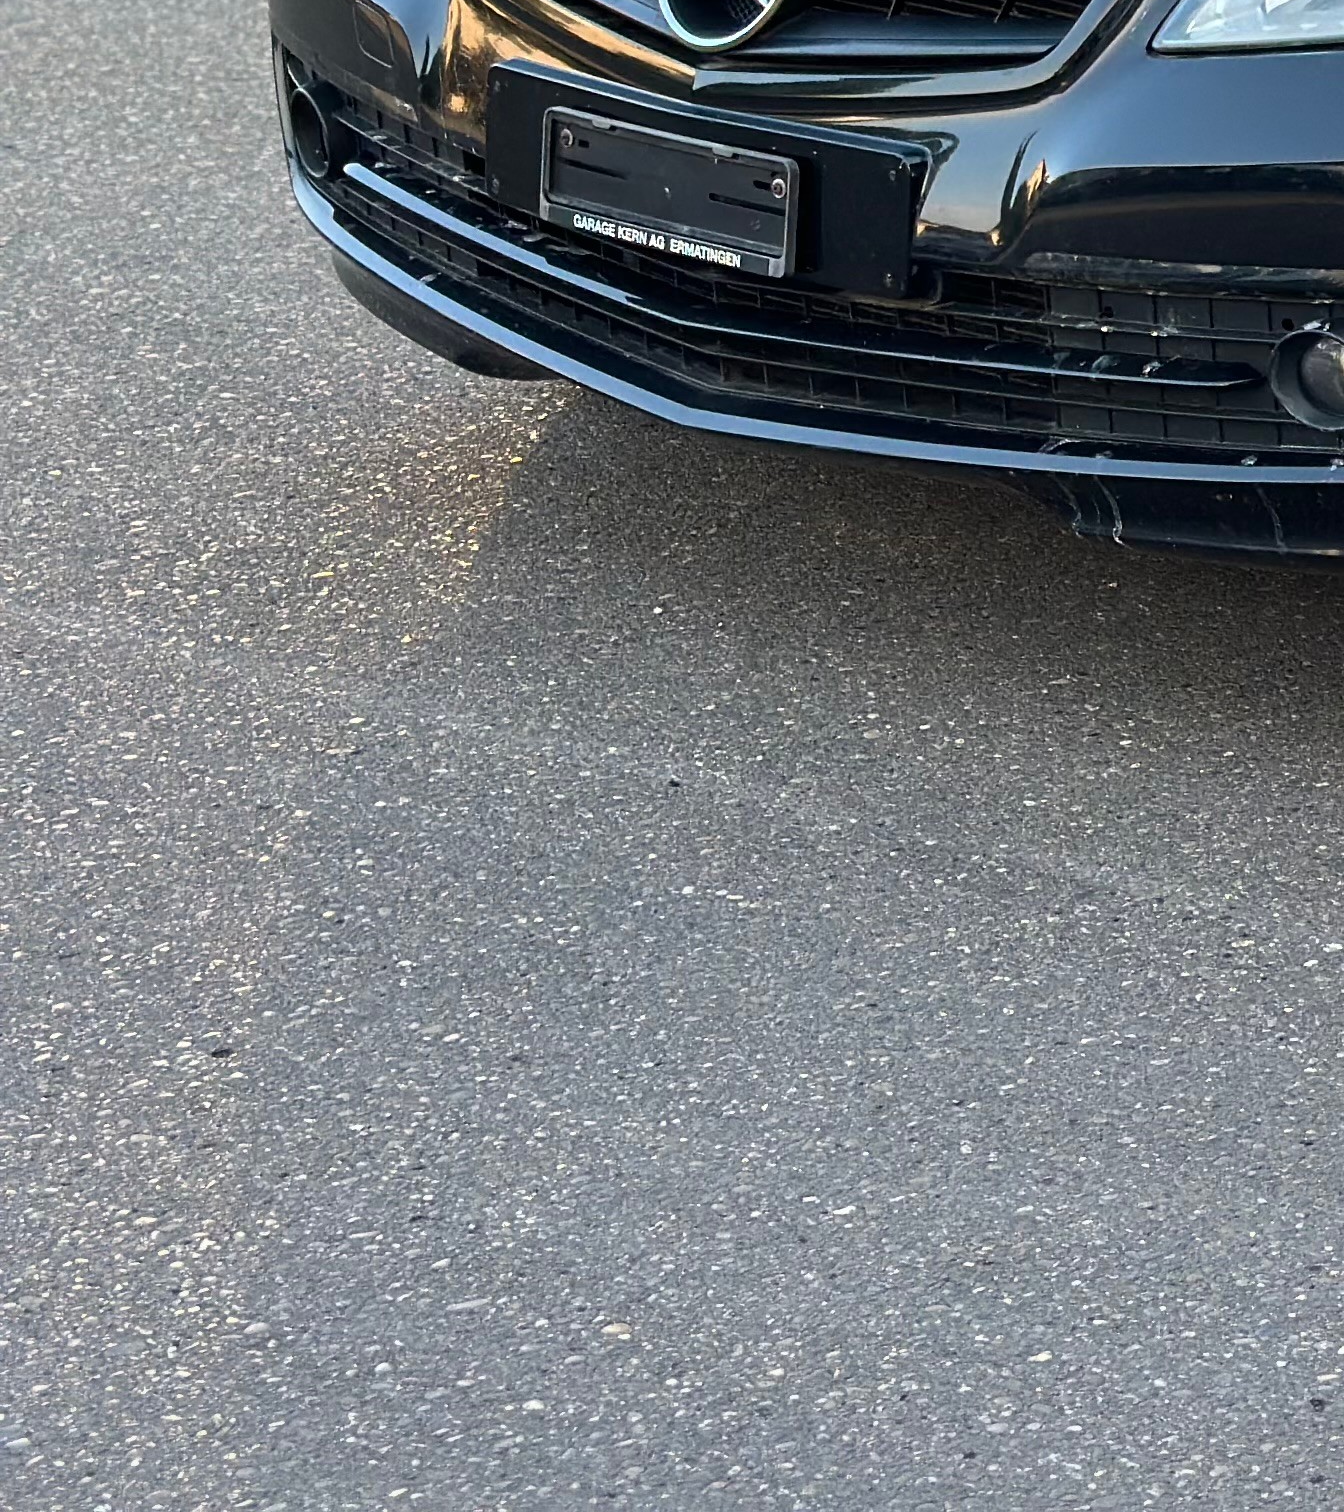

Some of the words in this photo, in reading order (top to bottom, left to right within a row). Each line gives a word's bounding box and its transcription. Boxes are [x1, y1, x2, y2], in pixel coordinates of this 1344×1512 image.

[573, 213, 616, 238] GARAGE
[617, 225, 648, 246] KERN
[648, 233, 665, 250] AG
[669, 237, 741, 268] ERMATINGEN
